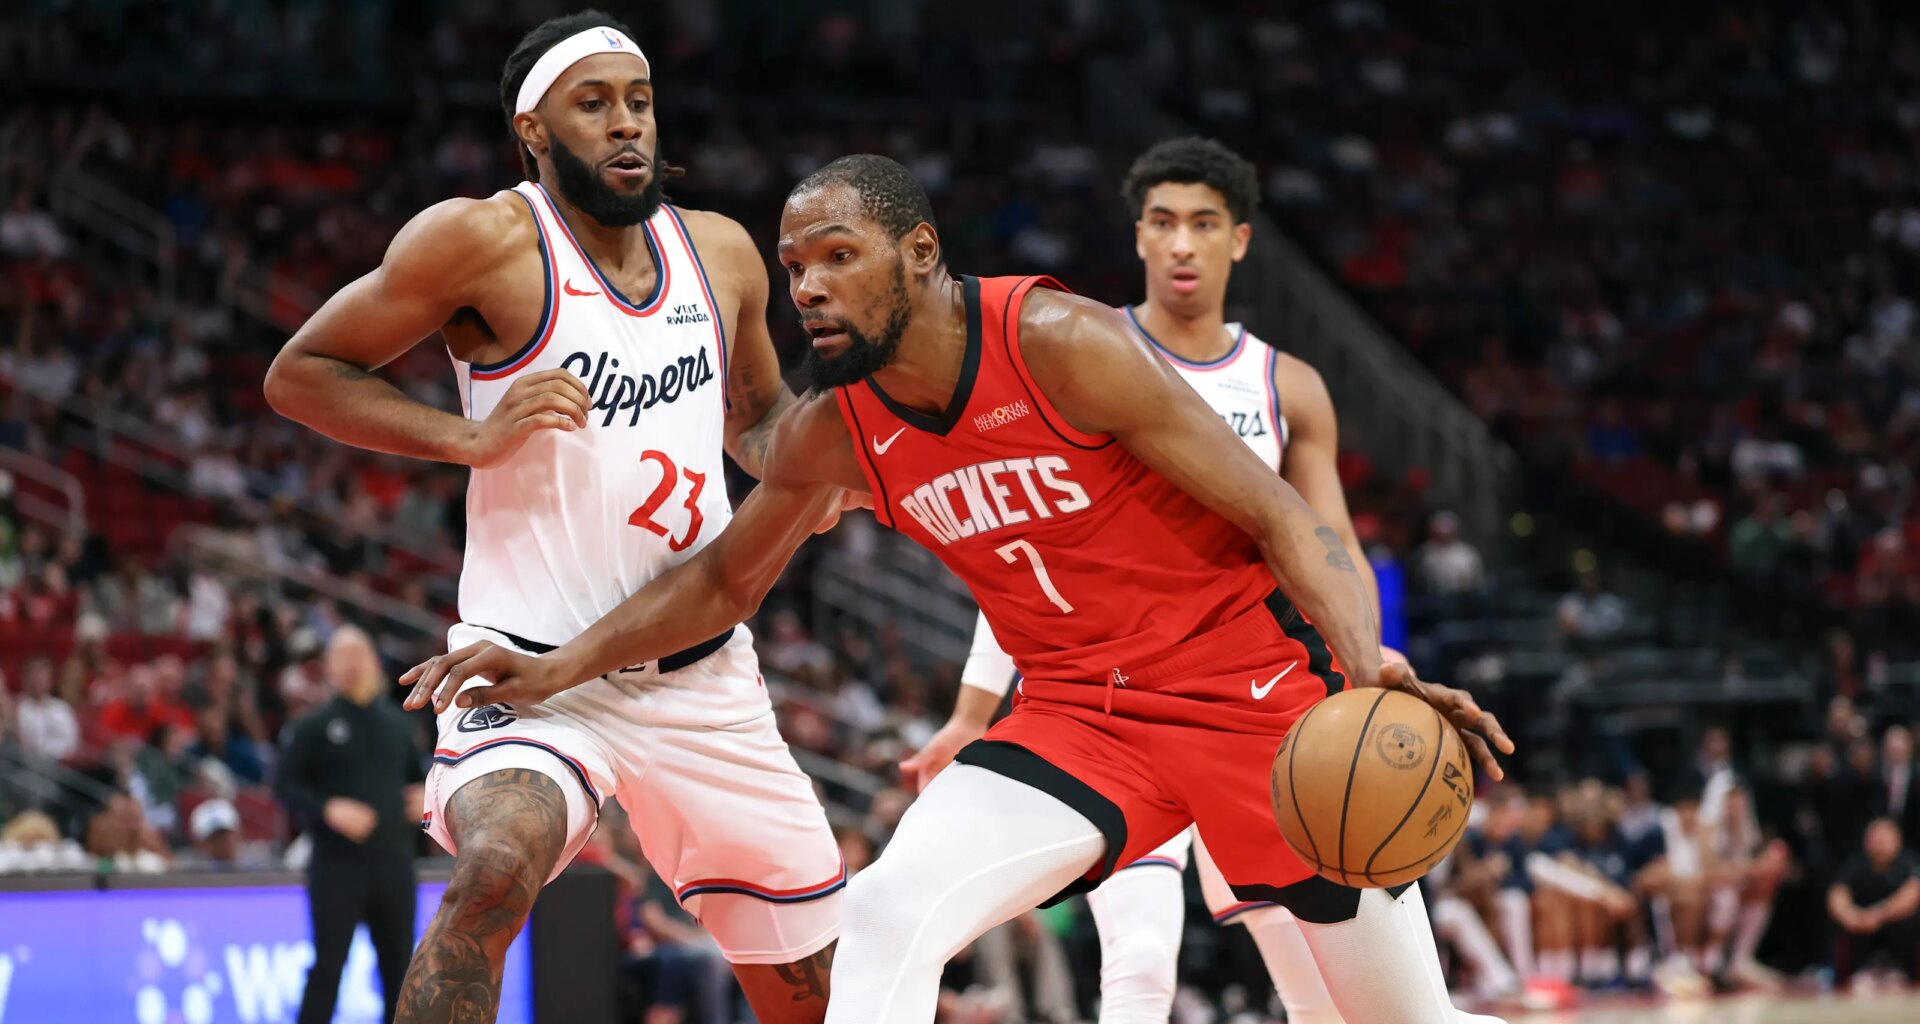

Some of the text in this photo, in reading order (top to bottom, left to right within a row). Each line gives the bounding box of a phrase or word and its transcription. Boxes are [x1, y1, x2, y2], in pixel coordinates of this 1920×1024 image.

[560, 345, 714, 427] Clippers
[973, 399, 1027, 425] MEMORIAL
[975, 405, 1030, 433] HERMANN
[628, 449, 706, 553] 23
[899, 455, 1092, 546] ROCKETS
[994, 539, 1075, 614] 7
